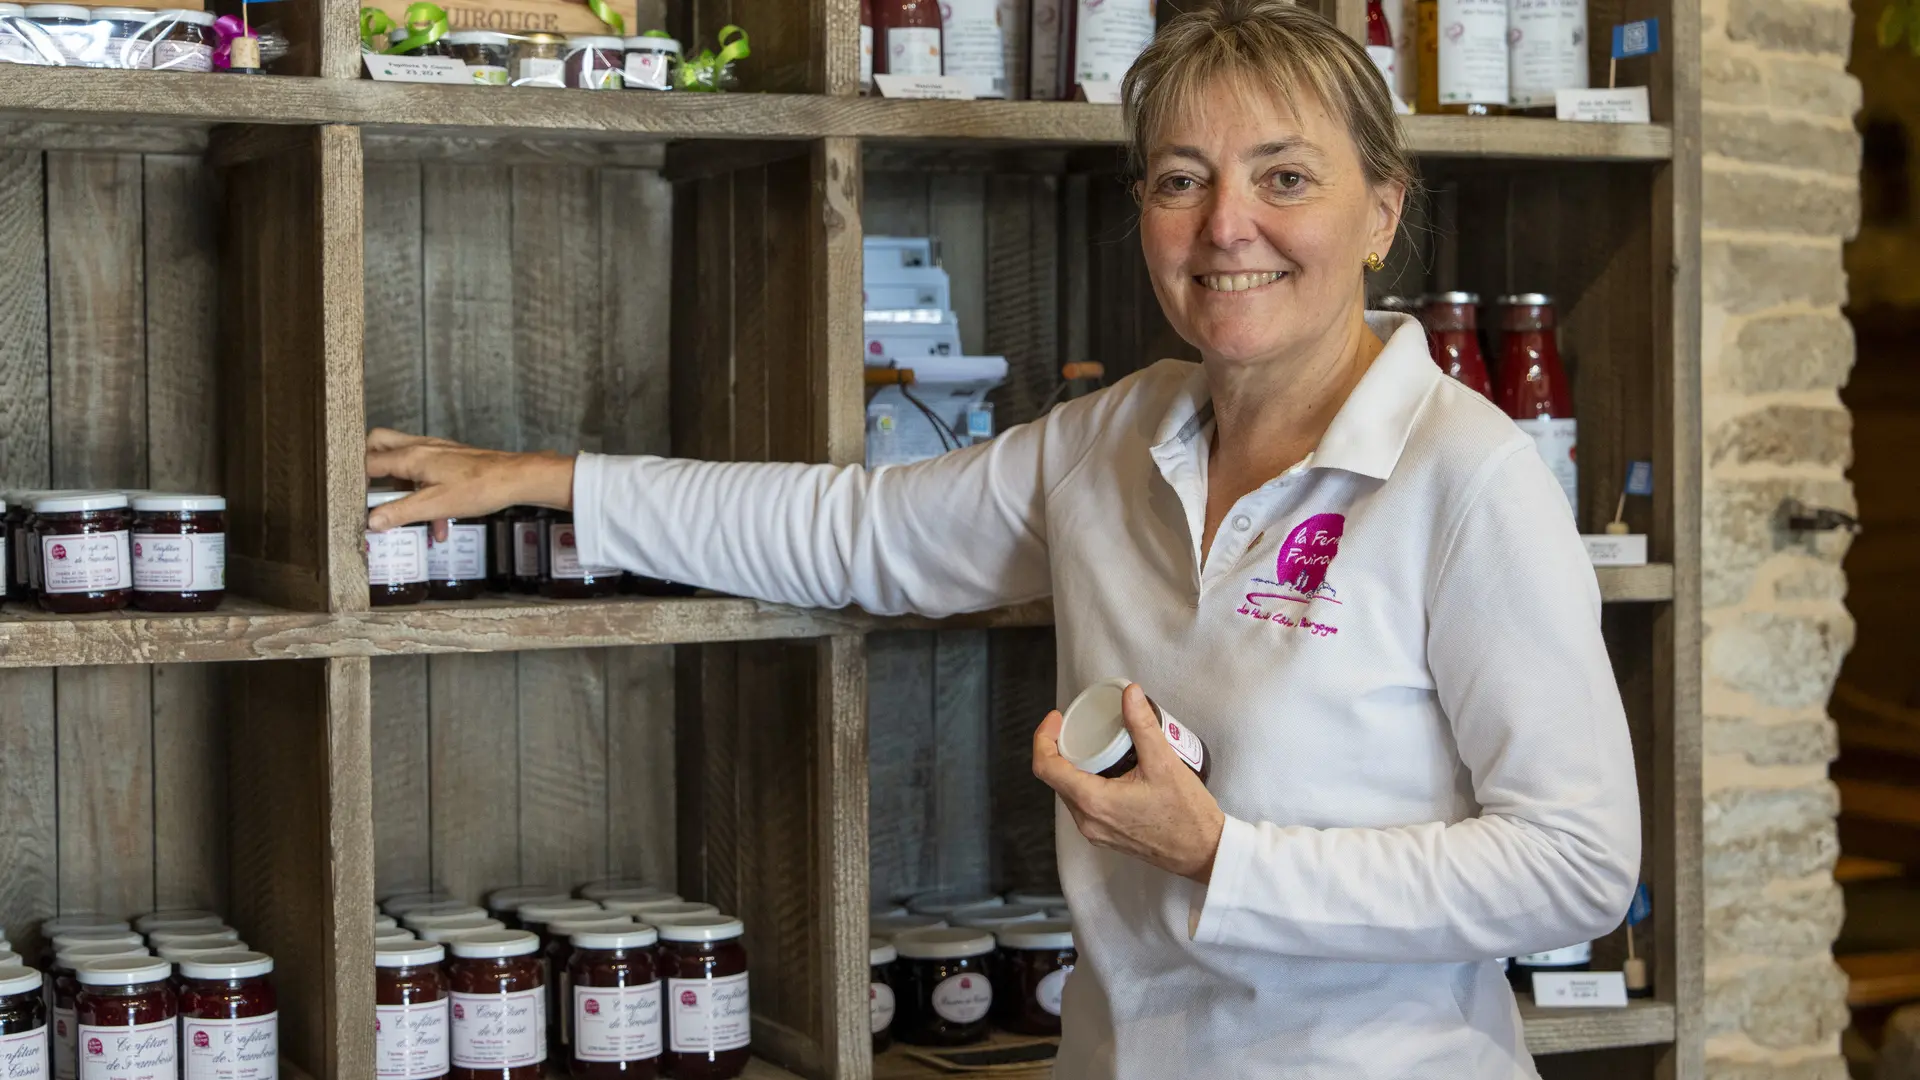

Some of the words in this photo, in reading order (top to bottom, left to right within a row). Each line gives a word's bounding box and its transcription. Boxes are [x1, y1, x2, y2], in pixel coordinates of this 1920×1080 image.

[1295, 527, 1307, 544] la
[1285, 547, 1330, 566] Fruiro
[106, 1058, 121, 1070] de
[212, 1050, 227, 1063] de
